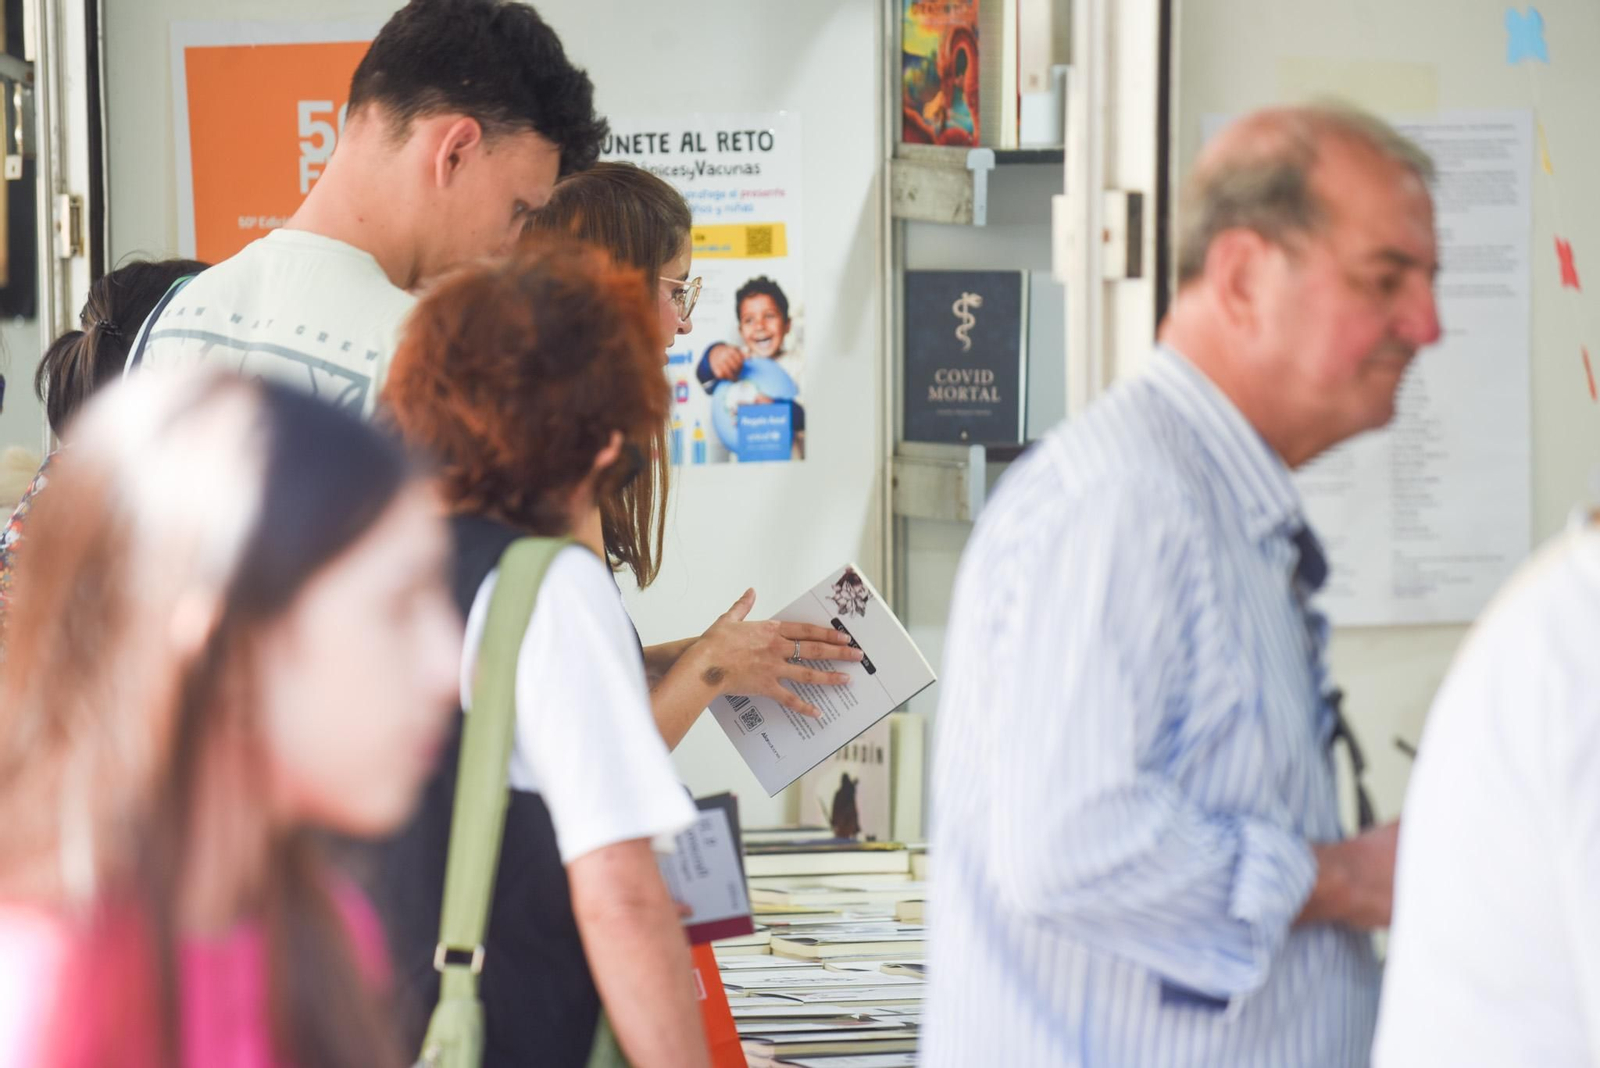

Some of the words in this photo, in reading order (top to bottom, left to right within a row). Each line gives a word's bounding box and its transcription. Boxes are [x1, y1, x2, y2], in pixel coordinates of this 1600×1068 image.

[680, 131, 706, 152] AL
[717, 130, 774, 151] RETO
[934, 368, 995, 385] COVID
[928, 385, 1001, 403] MORTAL
